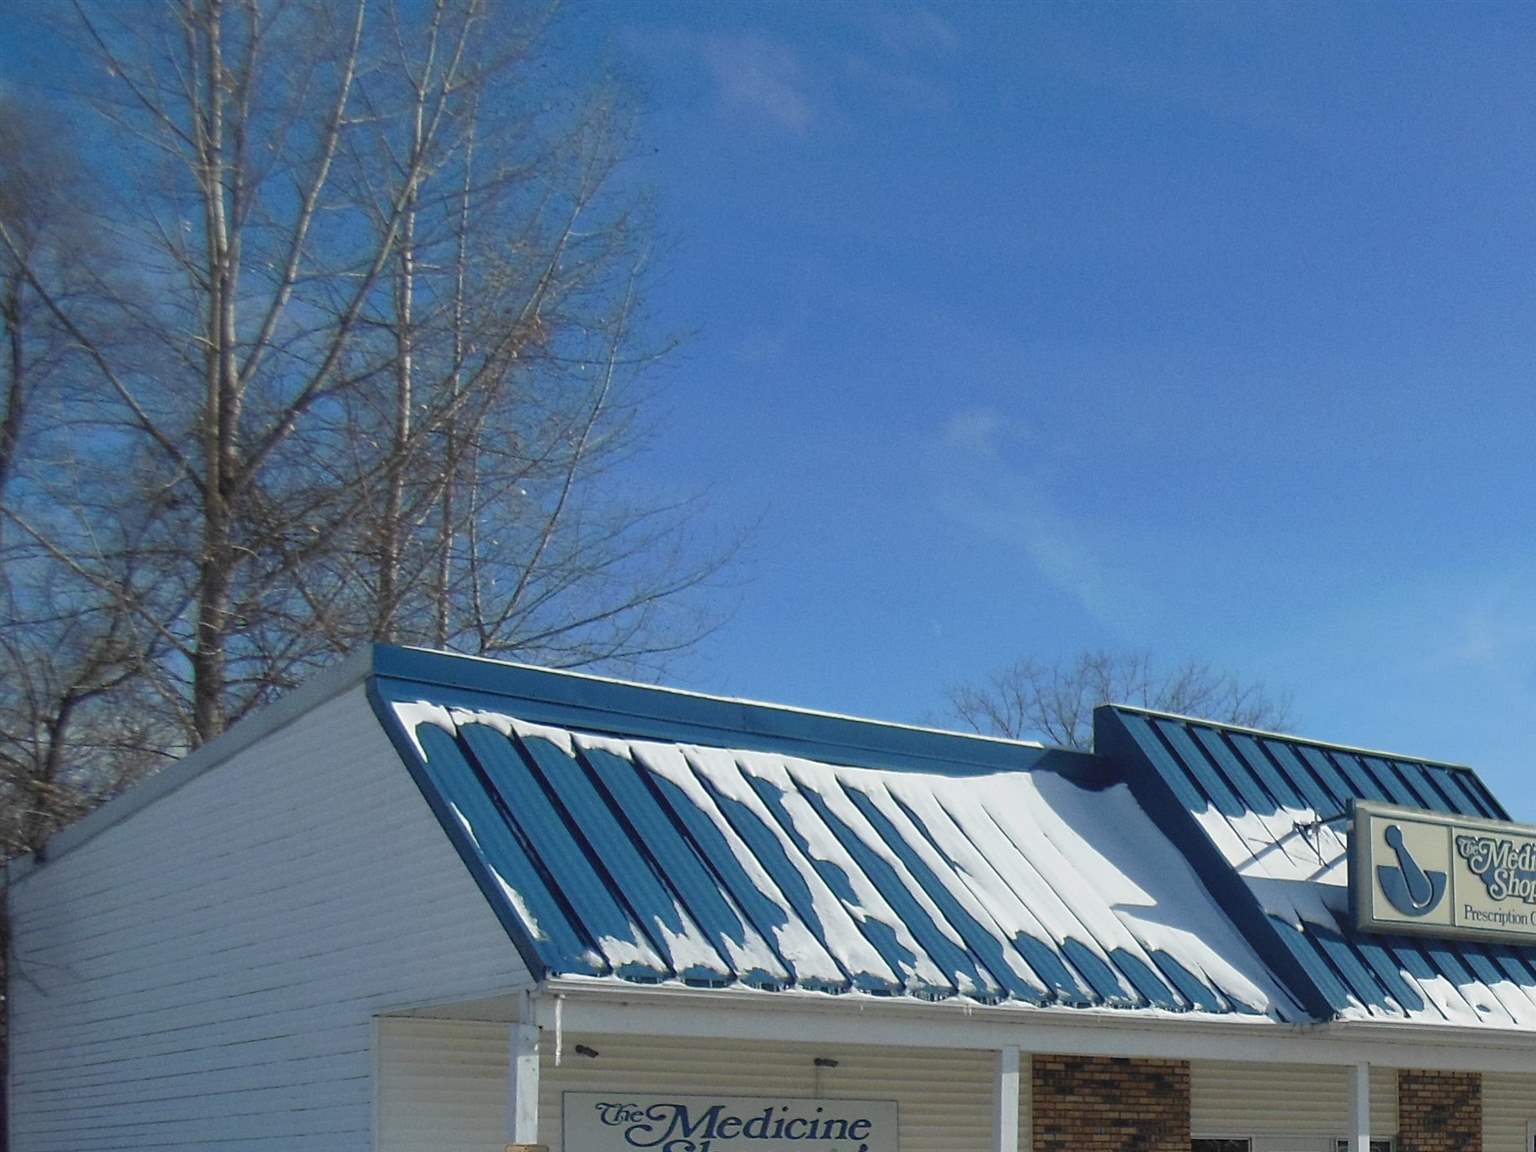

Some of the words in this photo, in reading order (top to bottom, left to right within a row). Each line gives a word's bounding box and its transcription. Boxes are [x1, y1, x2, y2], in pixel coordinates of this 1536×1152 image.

[1463, 904, 1528, 927] Prescription
[595, 1102, 644, 1126] The
[624, 1103, 872, 1148] Medicine
